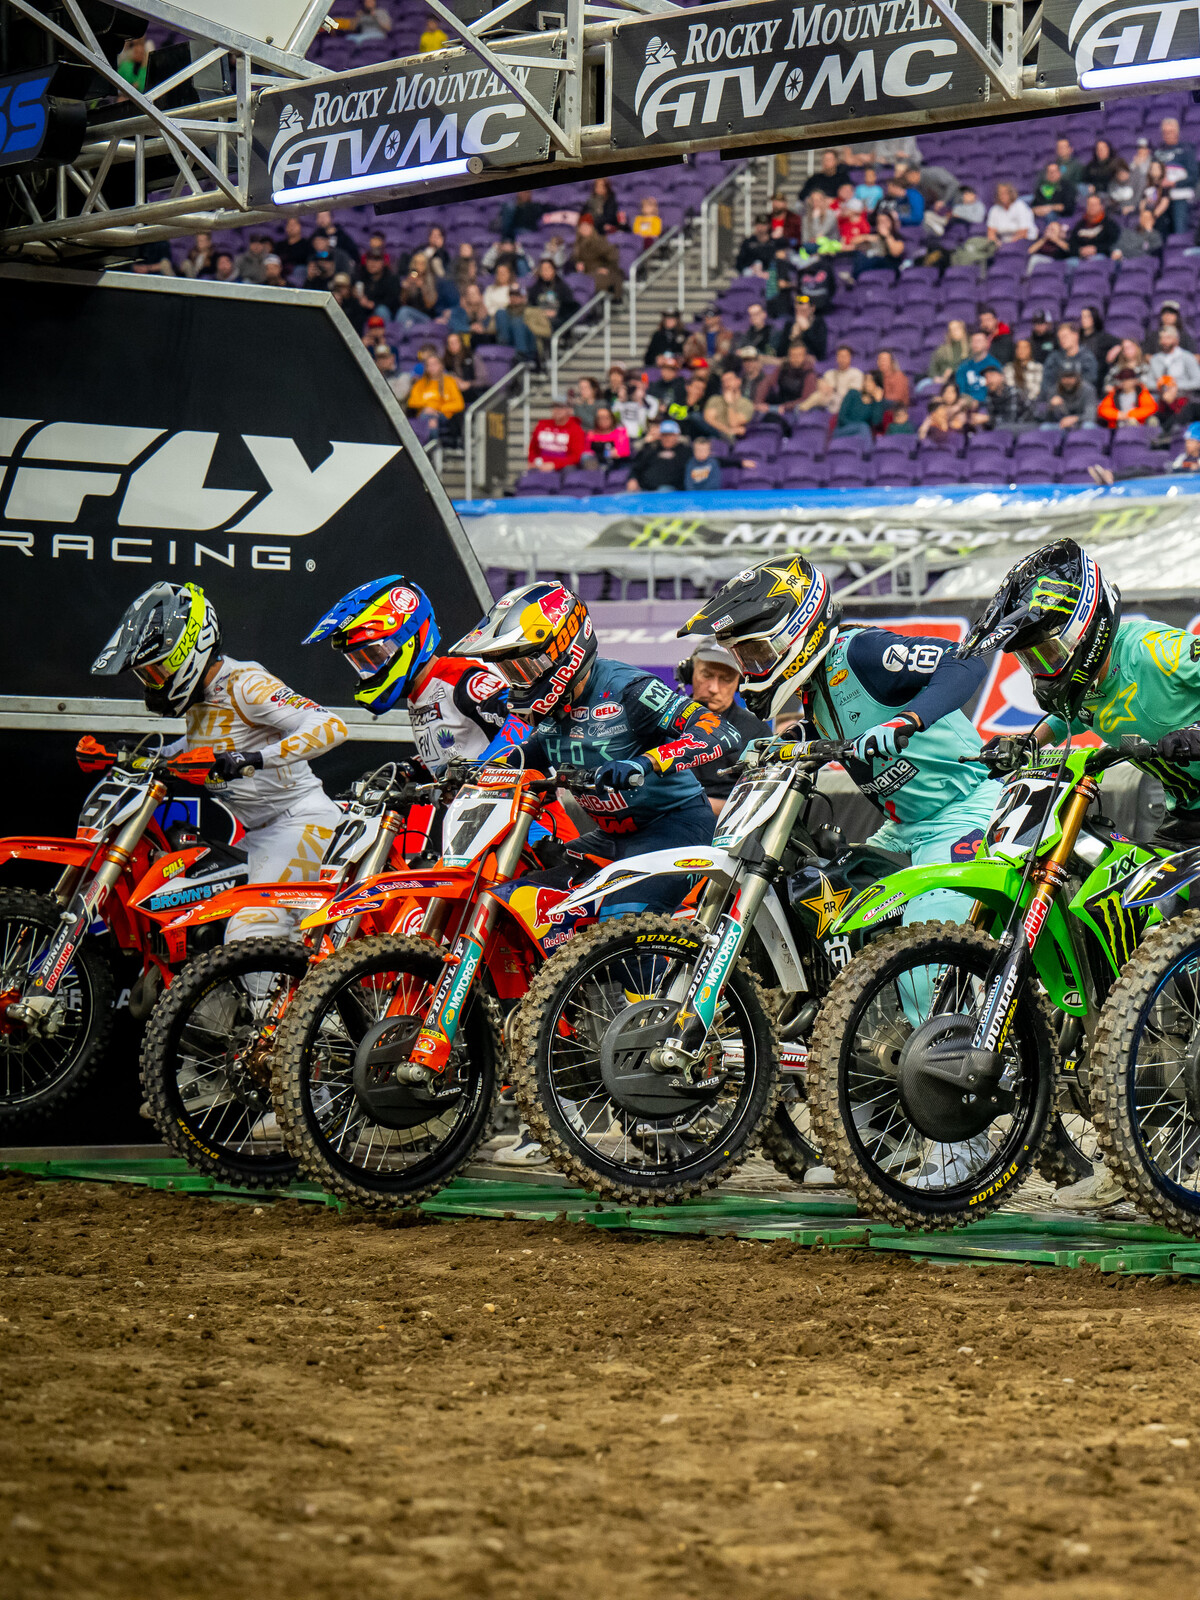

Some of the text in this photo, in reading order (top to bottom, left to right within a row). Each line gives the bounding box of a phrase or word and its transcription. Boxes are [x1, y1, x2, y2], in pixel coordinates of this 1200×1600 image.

[682, 18, 783, 66] ROCKY
[306, 86, 388, 130] ROCKY
[3, 421, 404, 536] FLY
[0, 531, 292, 571] RACING
[788, 582, 823, 637] SCOTT
[1078, 556, 1093, 623] SCOTT
[546, 600, 586, 661] 100%
[782, 622, 827, 680] ROCKSTAR
[1083, 617, 1107, 668] MONSTER
[1093, 628, 1110, 662] ENERGY
[595, 706, 619, 716] BELL
[644, 683, 671, 706] MX
[280, 717, 348, 759] FXR
[676, 745, 723, 772] Red Bull
[444, 803, 497, 855] 1
[987, 783, 1064, 849] 21
[322, 820, 366, 866] 12
[674, 859, 712, 868] FMF
[163, 858, 185, 878] COLE
[150, 886, 212, 910] BROWN'S
[42, 926, 69, 976] DUNLOP
[543, 935, 558, 950] Red
[635, 934, 699, 949] DUNLOP
[707, 928, 742, 987] MOTOREX
[46, 942, 74, 992] BRAKING
[453, 956, 479, 1010] MOTOREX
[980, 974, 1001, 1025] CARRILLO
[985, 965, 1019, 1052] DUNLOP
[968, 1161, 1019, 1206] DUNLOP
